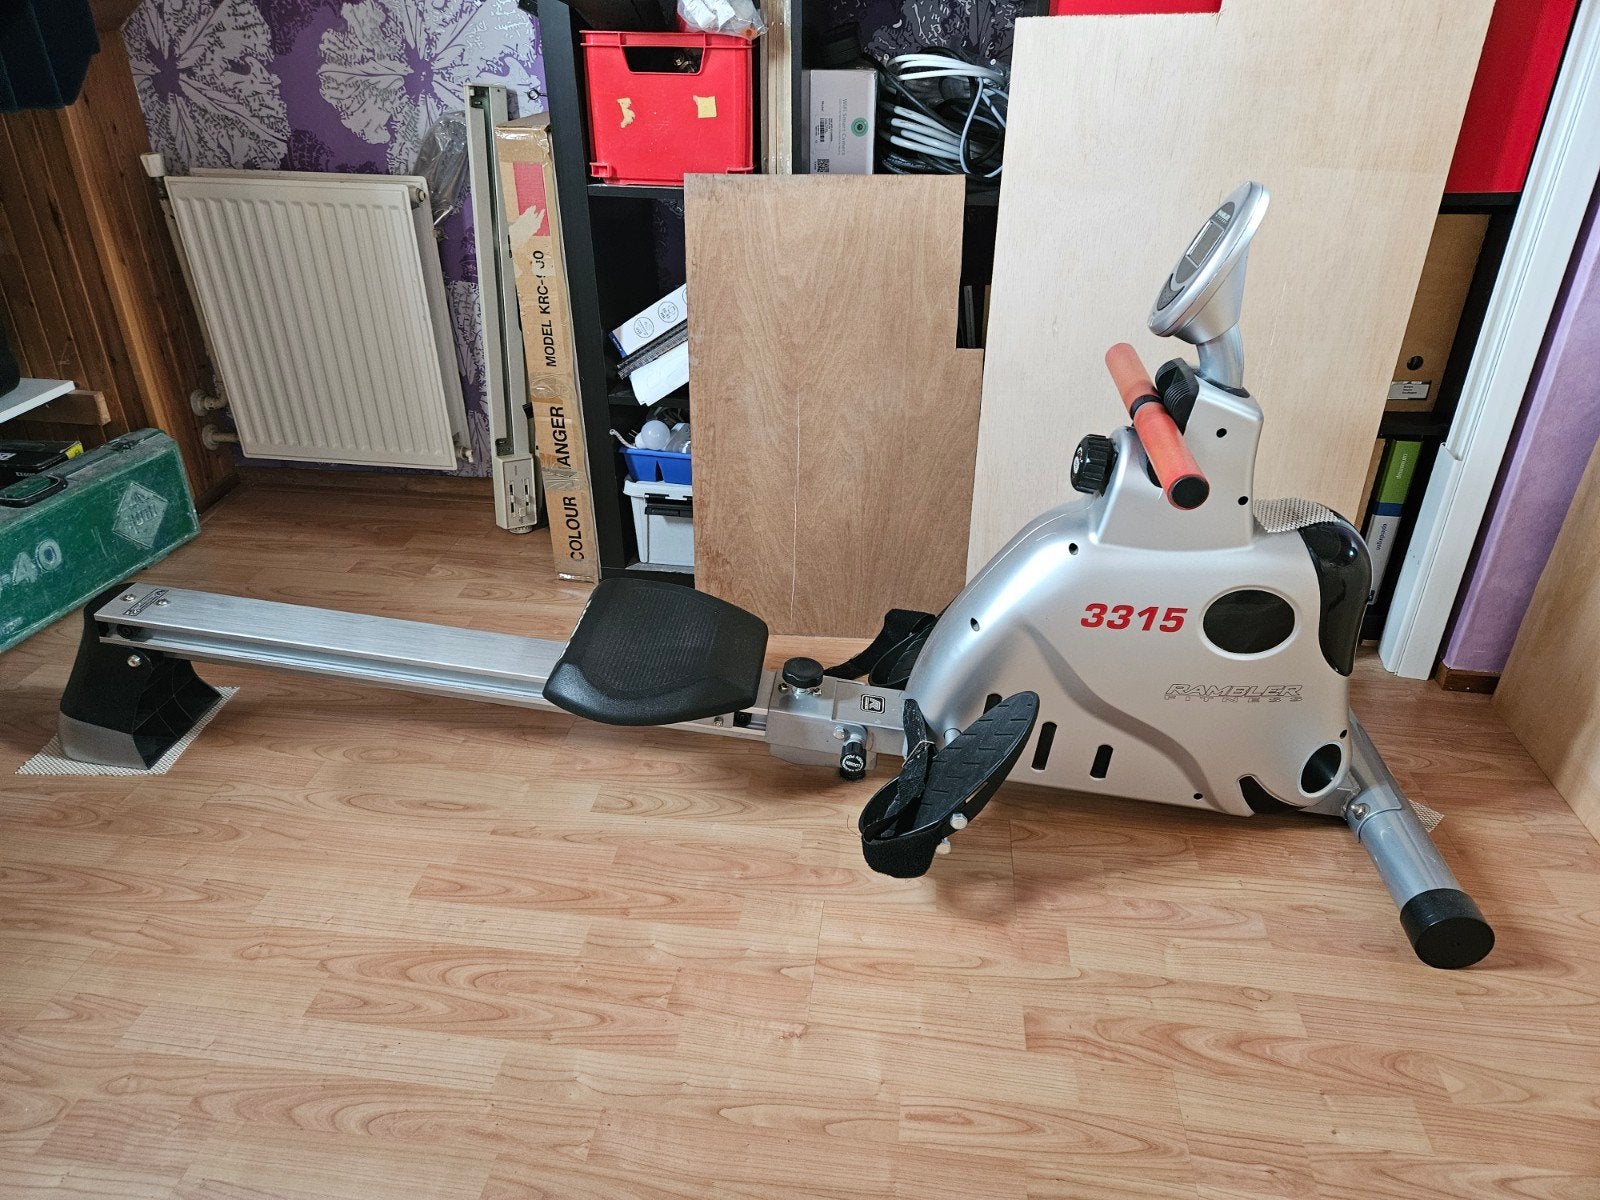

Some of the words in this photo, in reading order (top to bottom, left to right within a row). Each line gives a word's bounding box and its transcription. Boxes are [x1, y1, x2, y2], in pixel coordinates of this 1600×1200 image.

[533, 250, 550, 315] KRC-0
[541, 319, 557, 367] MODEL
[550, 405, 573, 476] ANGER
[562, 496, 585, 562] COLOUR
[1080, 603, 1188, 633] 3315
[1164, 683, 1303, 698] RAMBLER
